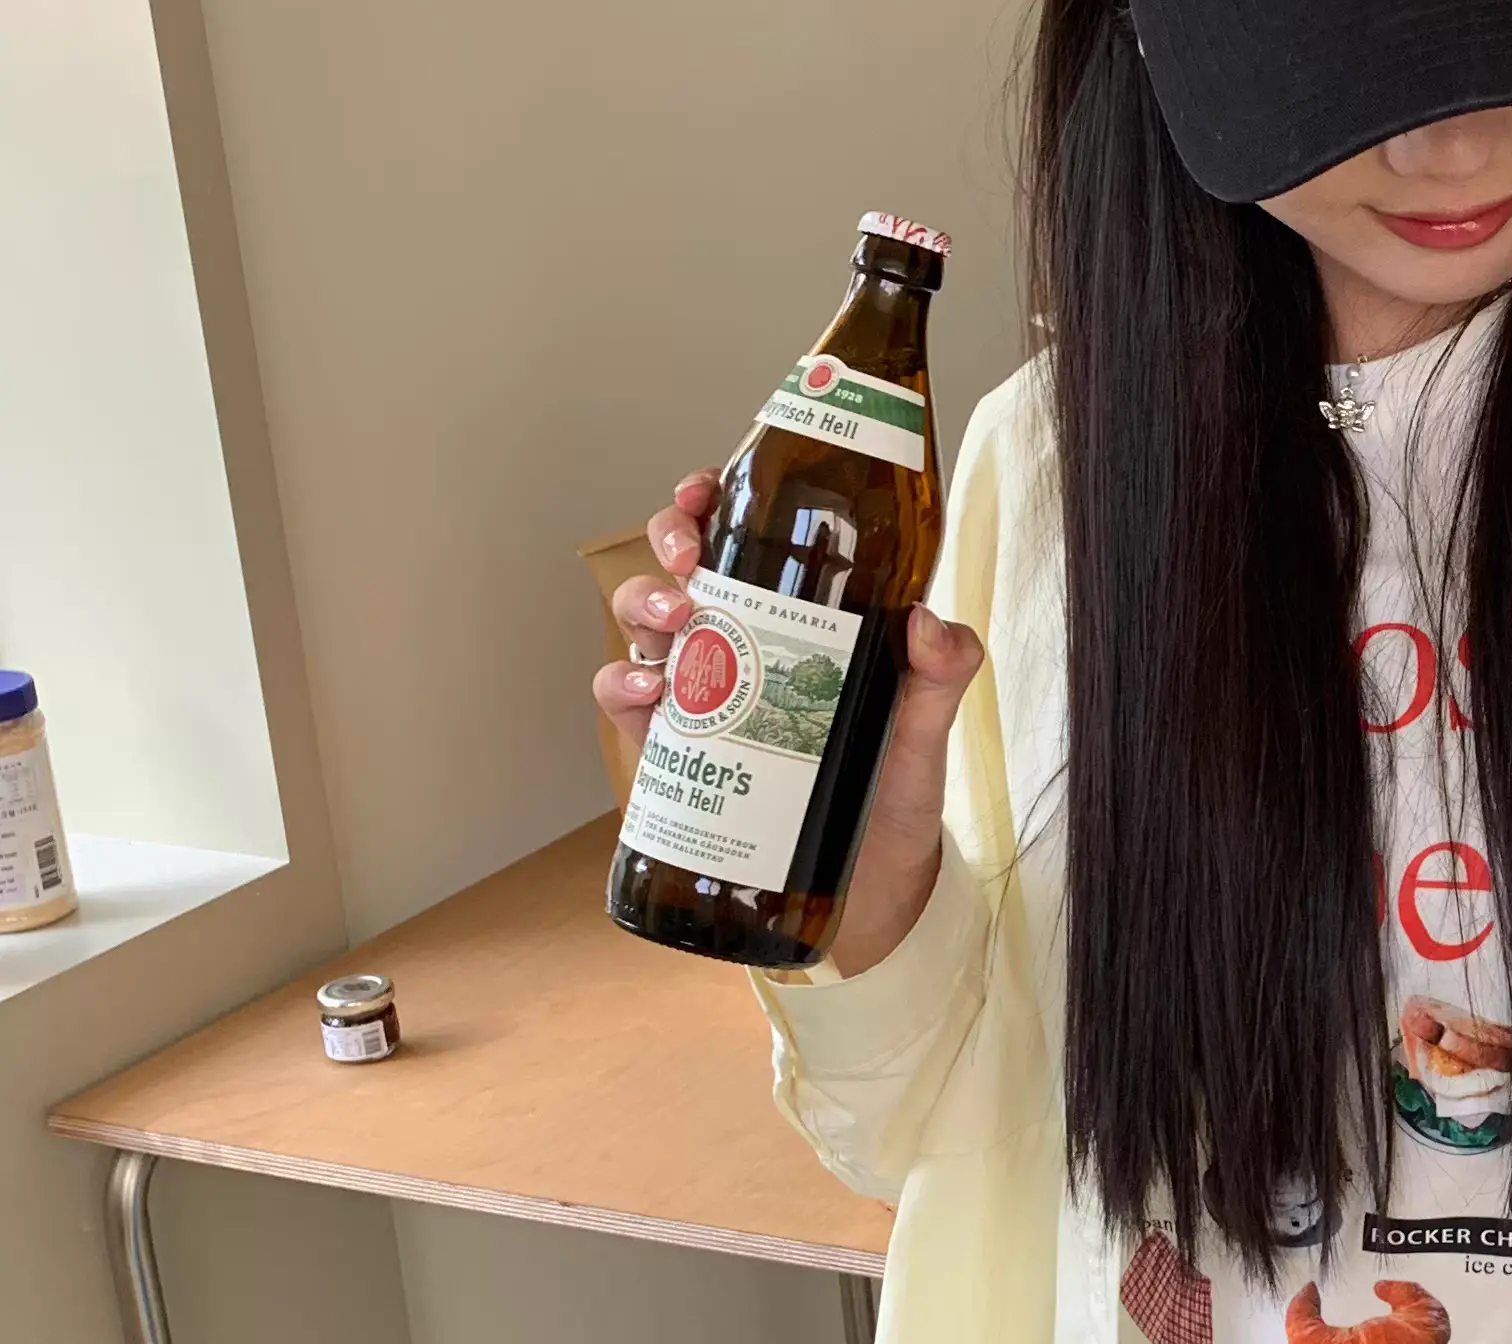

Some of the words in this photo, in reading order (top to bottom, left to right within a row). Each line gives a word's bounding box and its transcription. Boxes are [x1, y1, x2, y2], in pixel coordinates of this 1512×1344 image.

[818, 412, 859, 440] Hell
[744, 598, 763, 611] OF
[768, 605, 838, 633] BAVARIA
[717, 711, 729, 722] &
[726, 679, 752, 716] SOHN
[687, 787, 726, 816] Hell
[1464, 1255, 1496, 1275] ice
